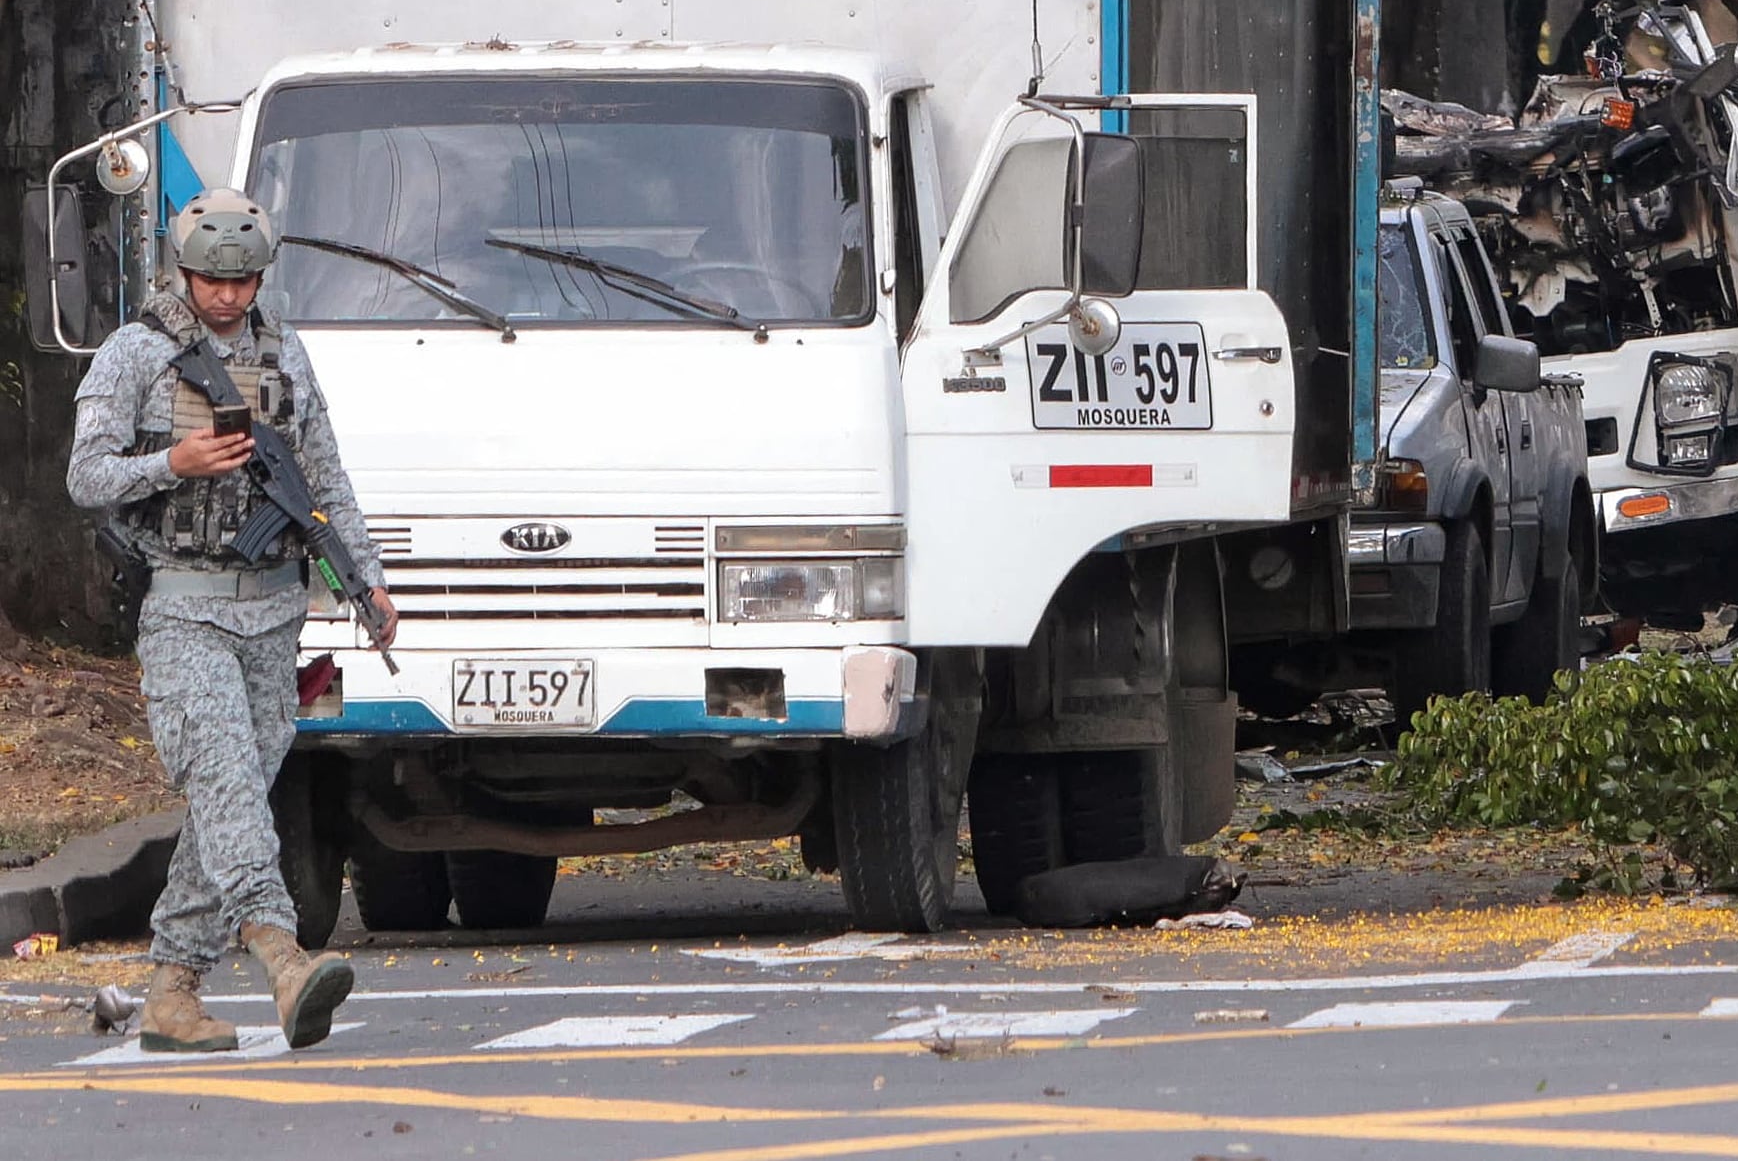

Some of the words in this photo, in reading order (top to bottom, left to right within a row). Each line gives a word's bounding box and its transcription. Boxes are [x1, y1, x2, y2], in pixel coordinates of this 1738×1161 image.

[1036, 343, 1109, 403] ZII
[1132, 342, 1199, 404] 597
[1077, 408, 1171, 425] MOSQUERA
[511, 524, 560, 548] KIA
[494, 709, 555, 723] MOSQUERA
